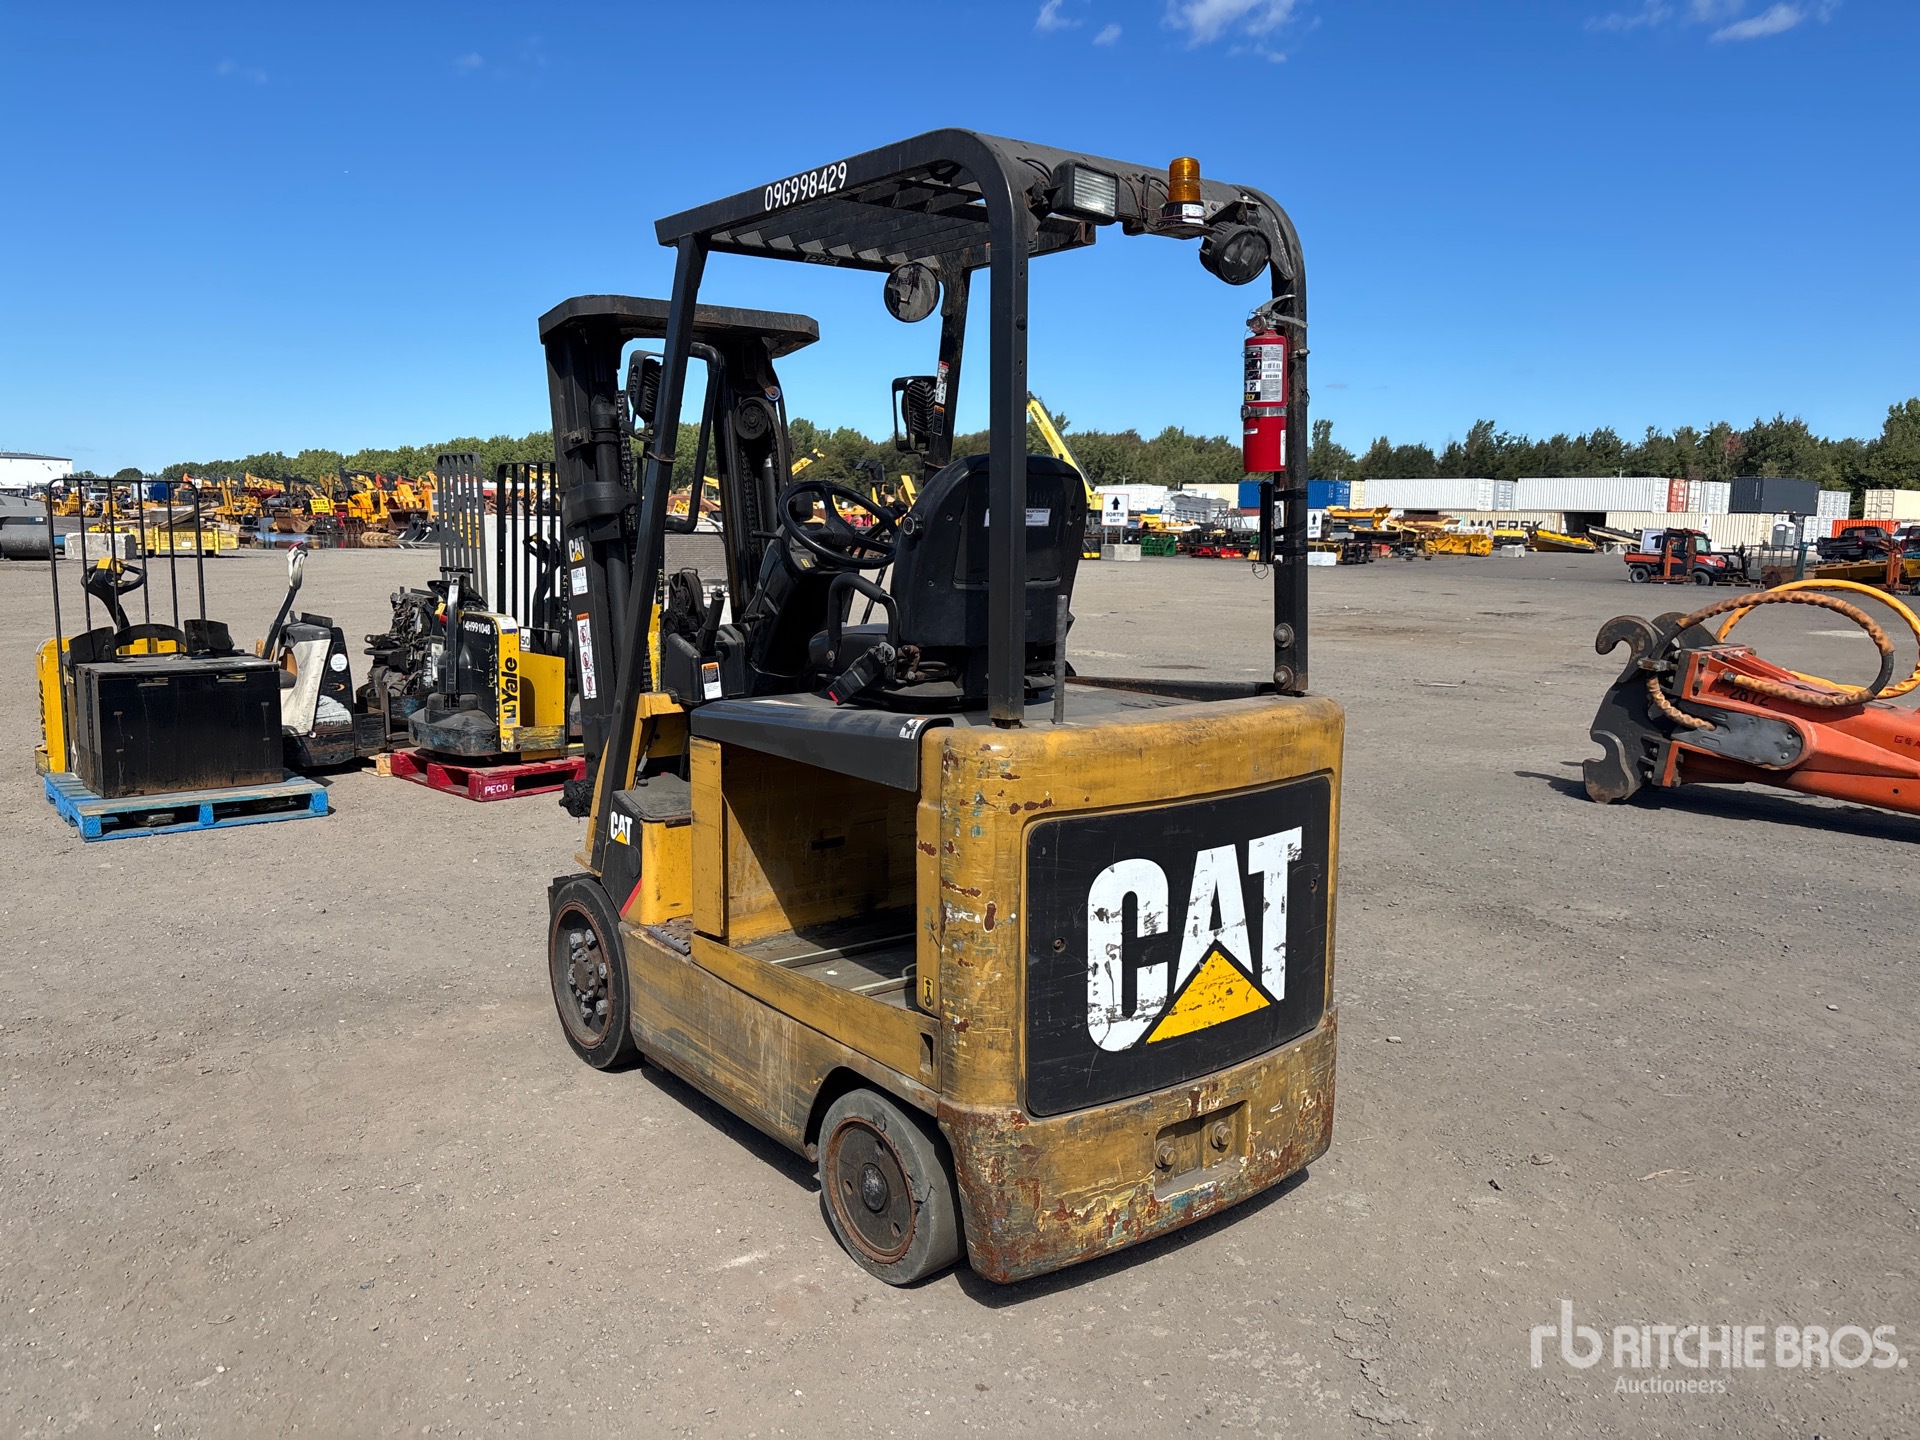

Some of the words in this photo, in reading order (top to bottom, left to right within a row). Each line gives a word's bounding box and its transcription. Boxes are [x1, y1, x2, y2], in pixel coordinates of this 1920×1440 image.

[765, 161, 847, 212] 09G998429
[568, 535, 585, 563] CAT
[501, 657, 518, 705] Yale
[484, 783, 509, 796] PECO
[610, 810, 633, 846] CAT
[1088, 826, 1302, 1051] CAT
